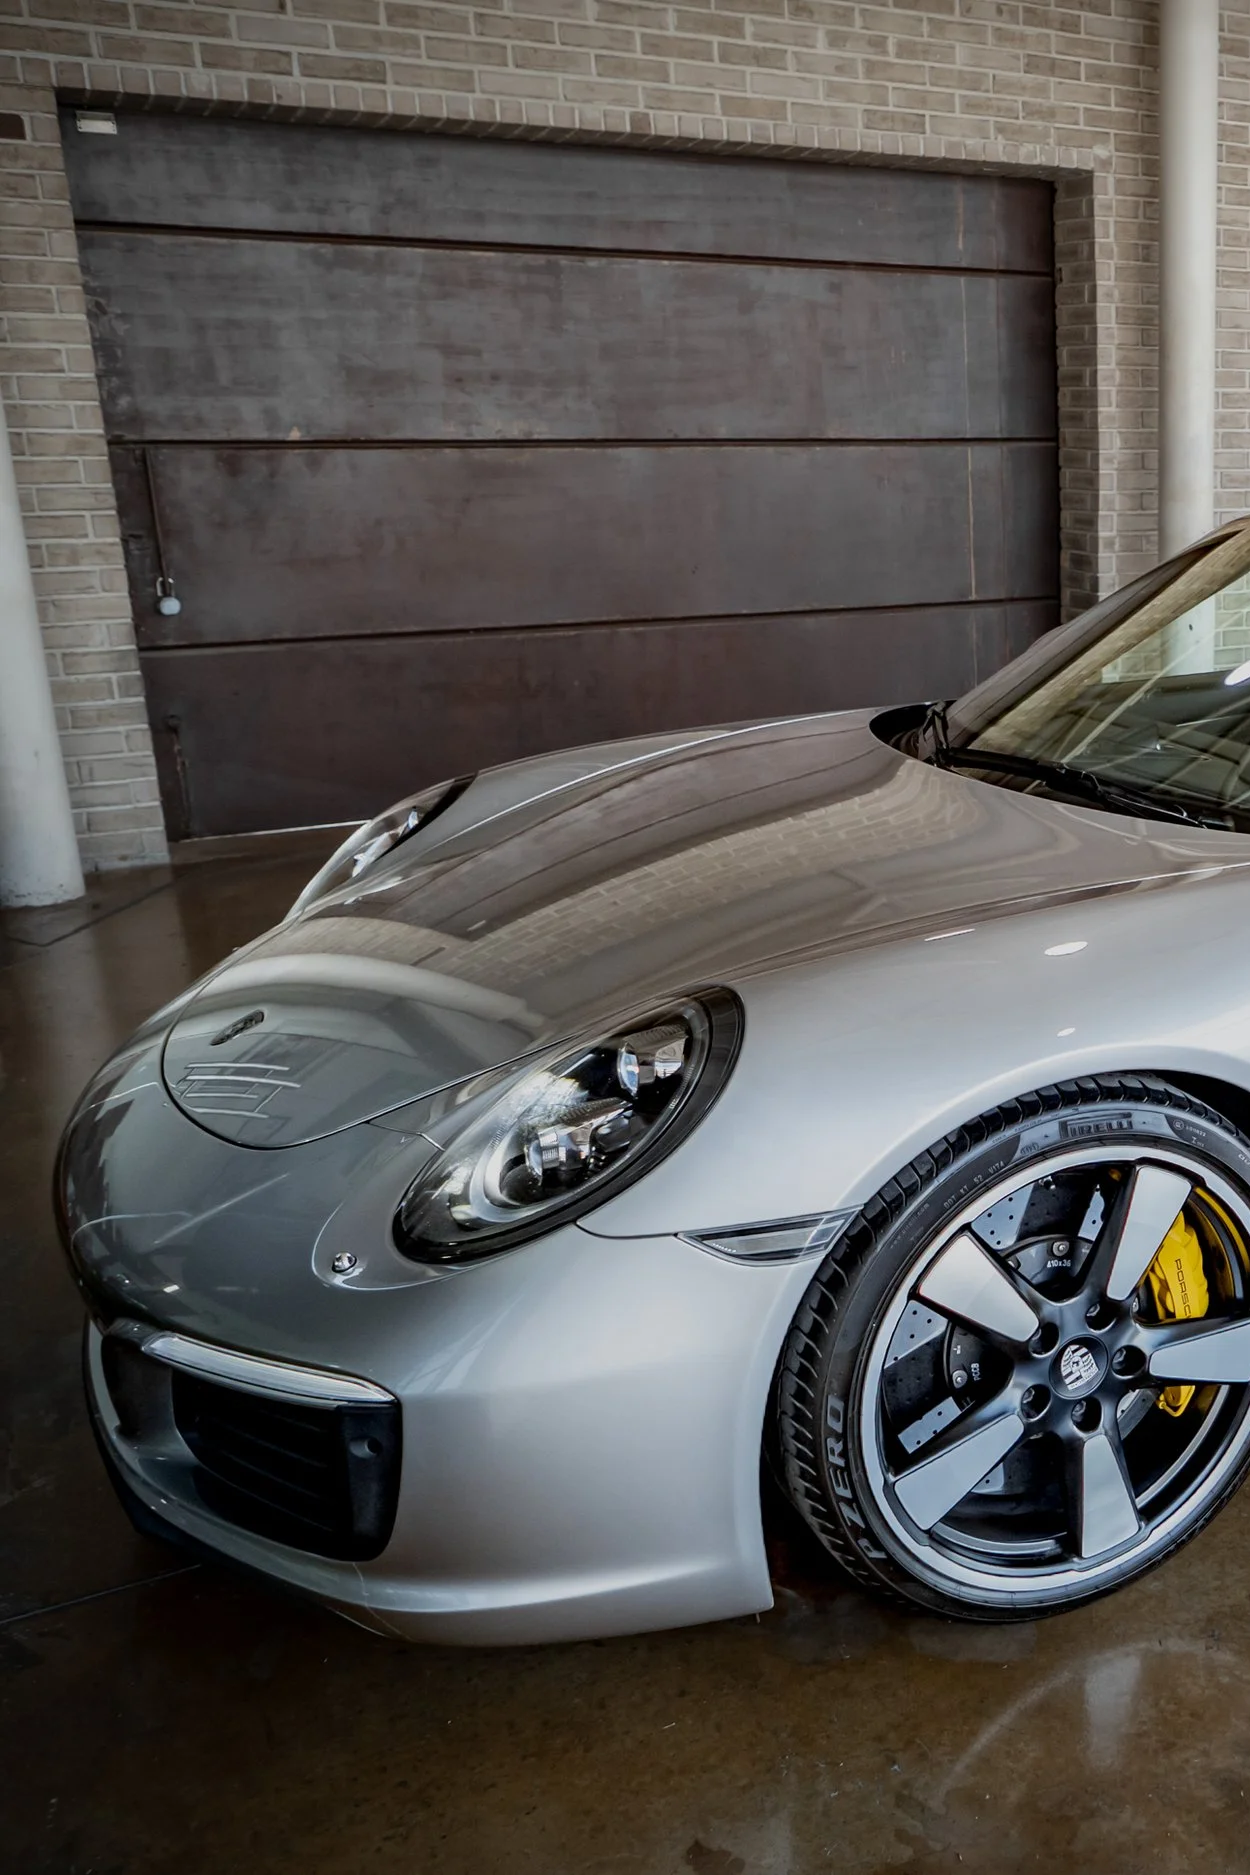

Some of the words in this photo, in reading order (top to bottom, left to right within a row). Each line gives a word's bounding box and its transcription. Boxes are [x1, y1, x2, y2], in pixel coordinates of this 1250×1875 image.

[1058, 1112, 1134, 1139] PIRELLI
[1175, 1258, 1192, 1318] PORSC
[970, 1363, 981, 1381] PCCB
[827, 1394, 866, 1529] ZERO
[857, 1537, 888, 1559] P
